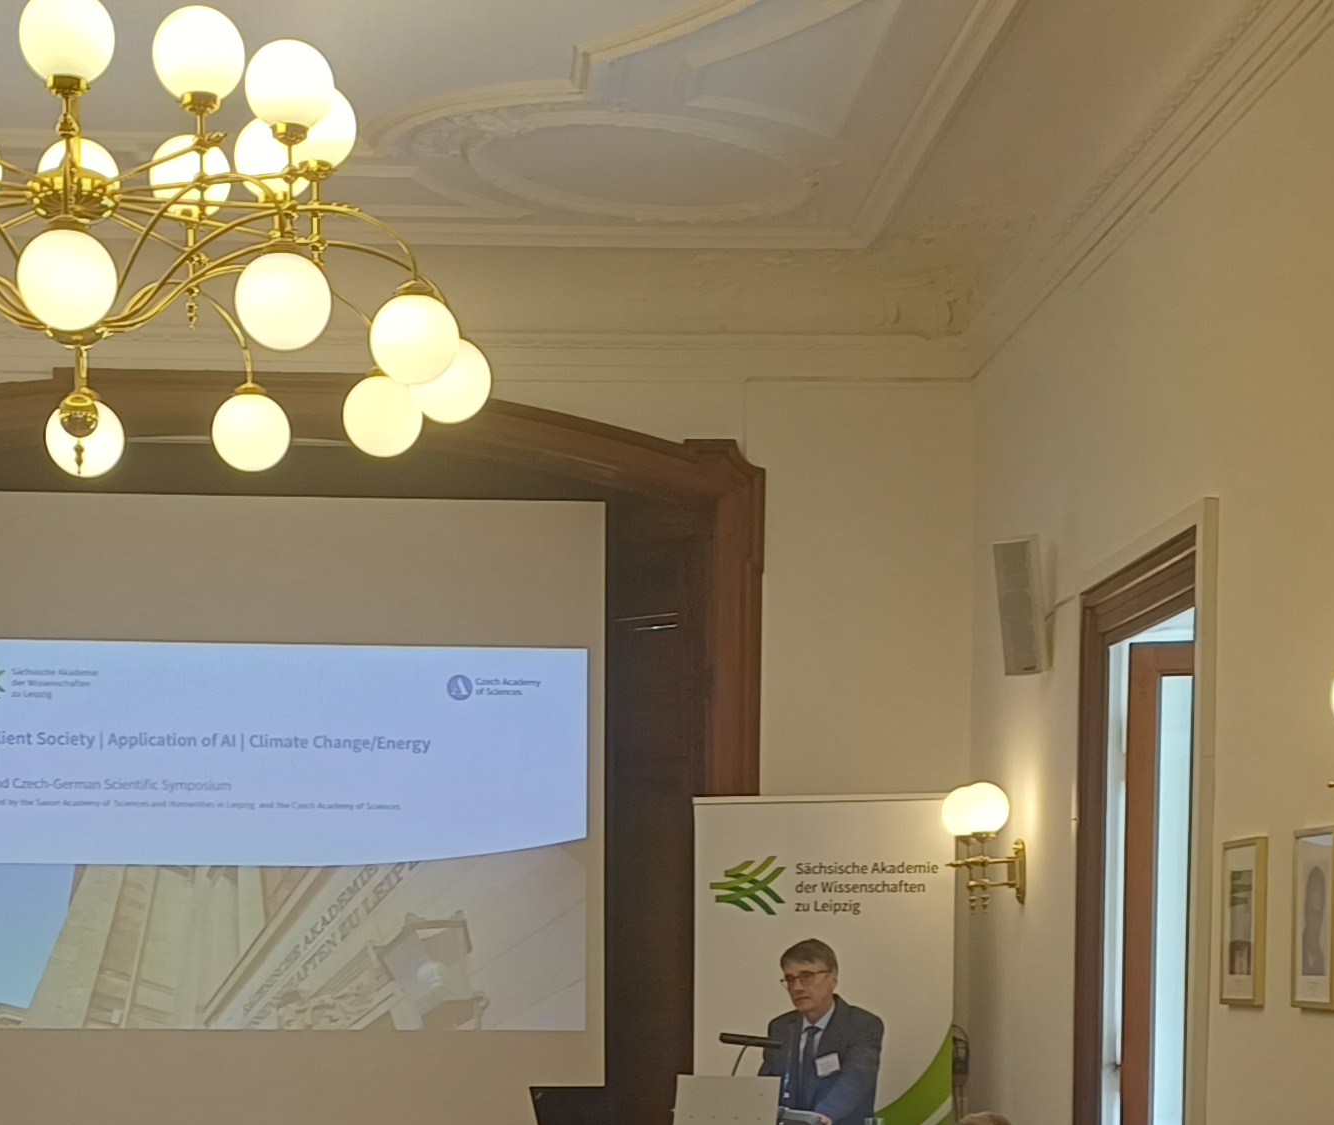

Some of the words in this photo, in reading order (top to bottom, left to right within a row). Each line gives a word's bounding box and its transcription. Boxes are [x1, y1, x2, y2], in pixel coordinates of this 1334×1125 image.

[36, 731, 96, 749] Society
[107, 732, 197, 750] Application
[201, 733, 218, 748] of
[220, 734, 236, 748] AI
[249, 734, 309, 749] Climate
[313, 735, 431, 754] Change/Energy
[12, 778, 101, 790] Czech-German
[104, 778, 158, 791] Scientific
[161, 780, 232, 794] Symposium
[795, 862, 868, 875] Sächsische
[871, 862, 939, 874] Akademie
[795, 881, 818, 894] der
[821, 880, 926, 893] Wissenschaften
[795, 902, 810, 912] zu
[814, 900, 861, 916] Leipzig
